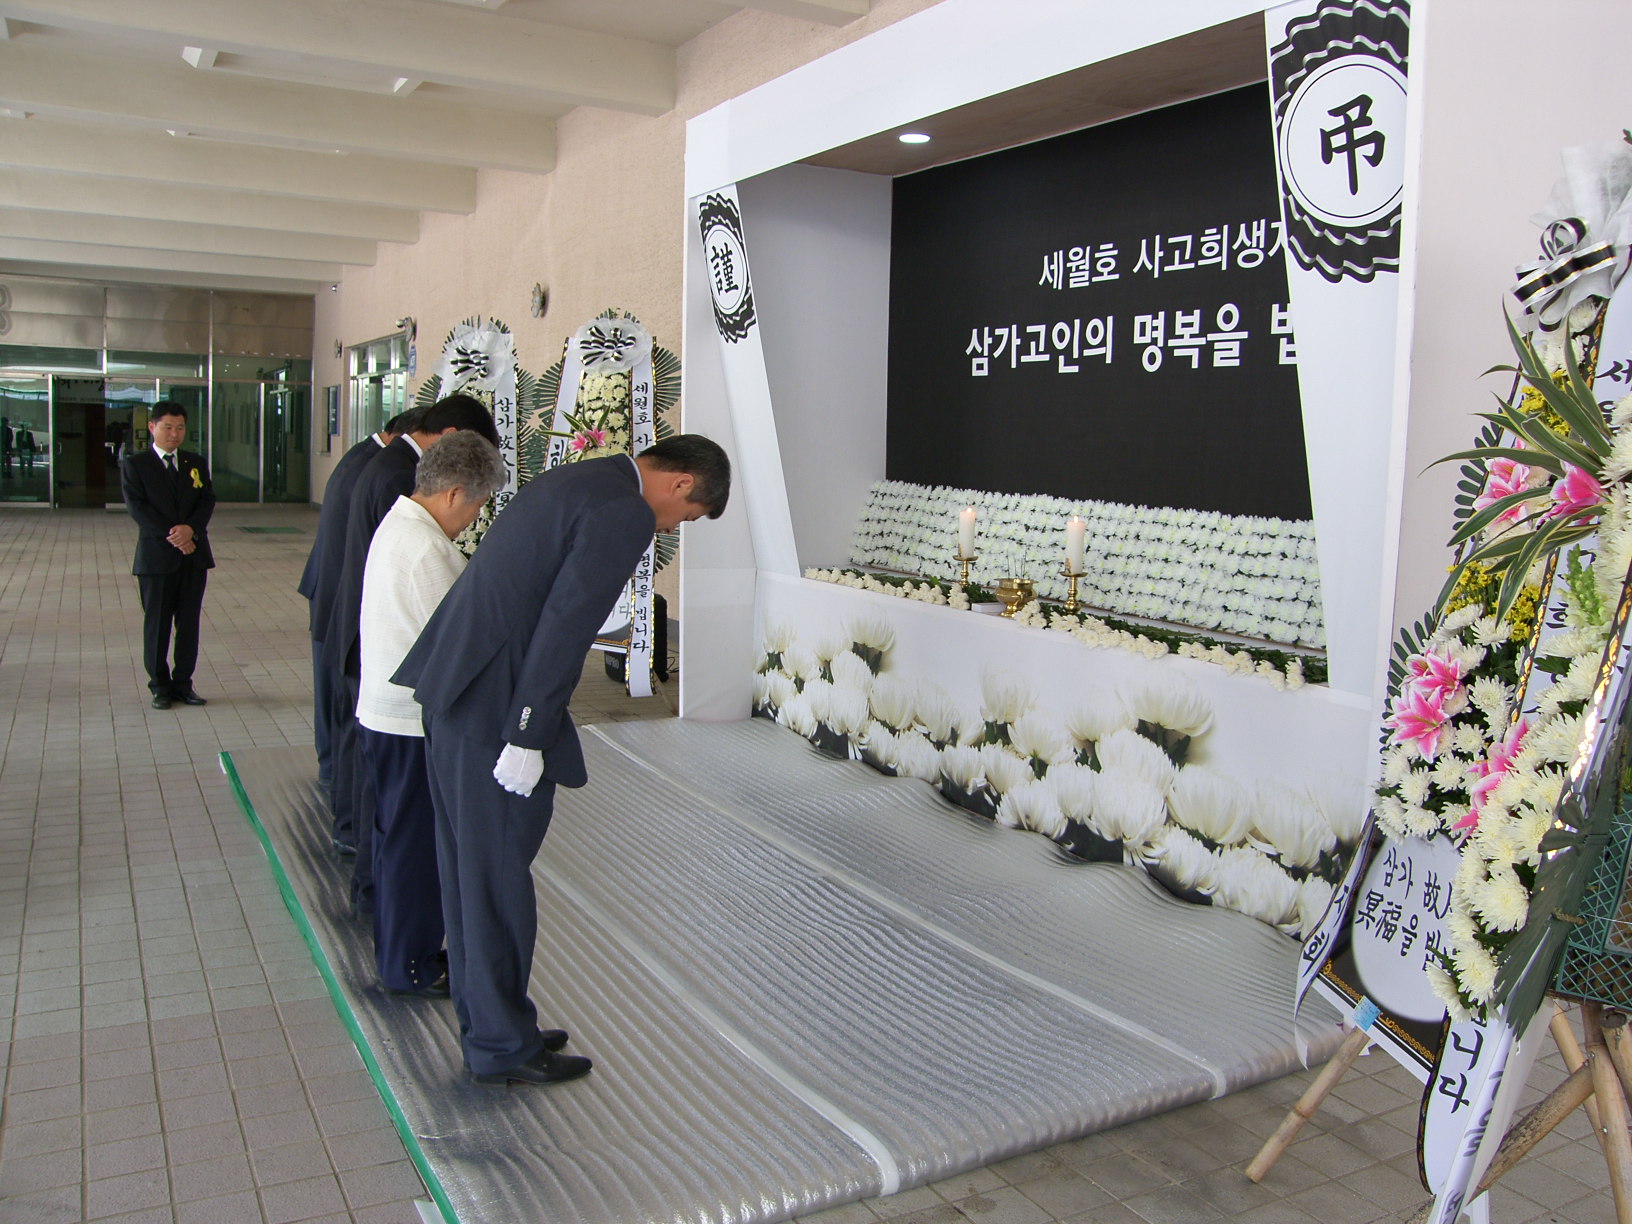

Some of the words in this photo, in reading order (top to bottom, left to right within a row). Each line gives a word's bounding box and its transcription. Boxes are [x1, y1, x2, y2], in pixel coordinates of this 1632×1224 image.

[1320, 94, 1385, 195] 弔
[711, 242, 739, 295] 謹
[1038, 243, 1120, 290] 세월호
[965, 315, 1114, 377] 삼가고인의
[1133, 302, 1249, 373] 명복을
[495, 397, 514, 429] 삼가
[633, 381, 652, 425] 세월호
[633, 606, 650, 654] 빕니다
[1383, 846, 1413, 900] 삼가
[1440, 1017, 1488, 1115] 니다
